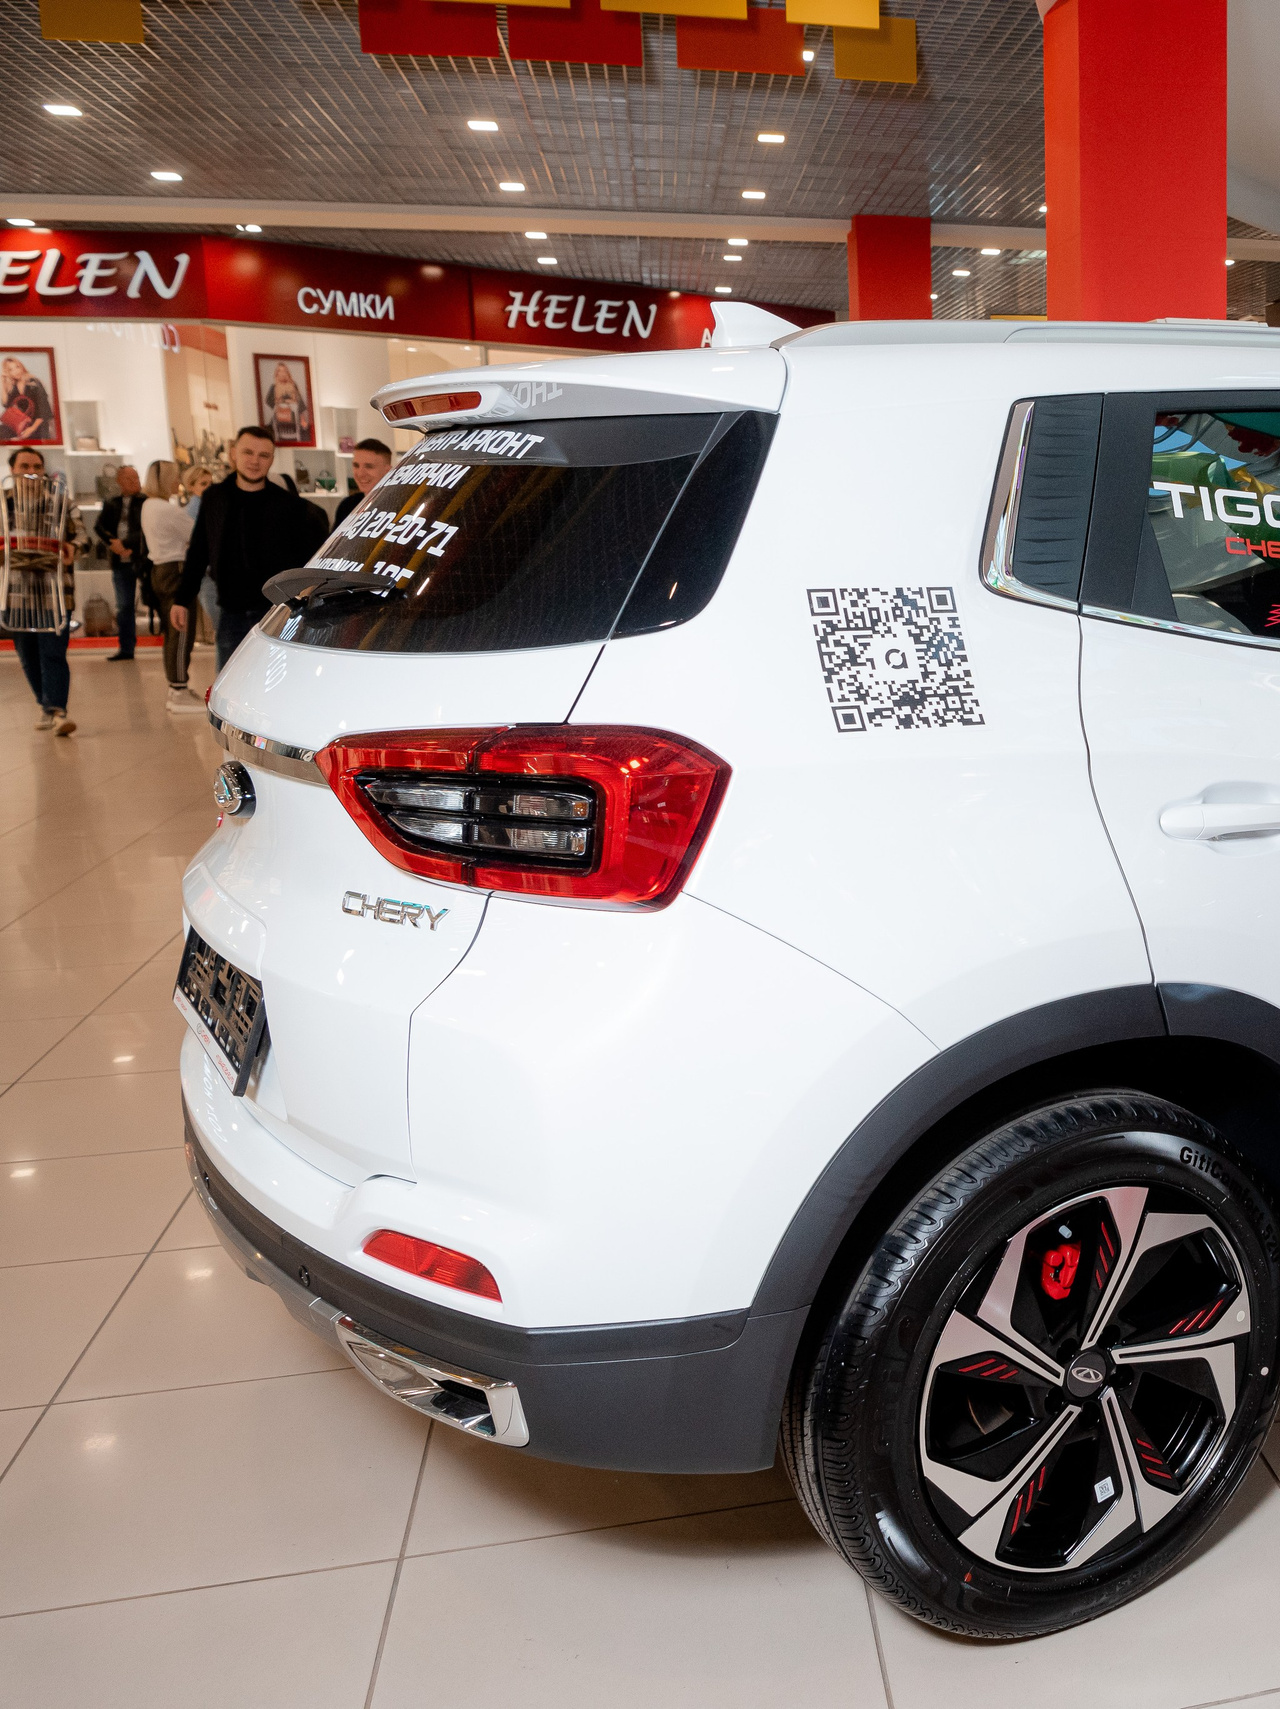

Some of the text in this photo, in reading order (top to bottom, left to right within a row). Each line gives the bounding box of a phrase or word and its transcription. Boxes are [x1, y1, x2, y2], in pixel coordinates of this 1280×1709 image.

[297, 286, 395, 320] СУМКИ
[505, 290, 657, 339] HELEN
[453, 429, 545, 460] АРКОНТ
[359, 511, 459, 557] 20-20-71
[341, 890, 450, 931] CHERY
